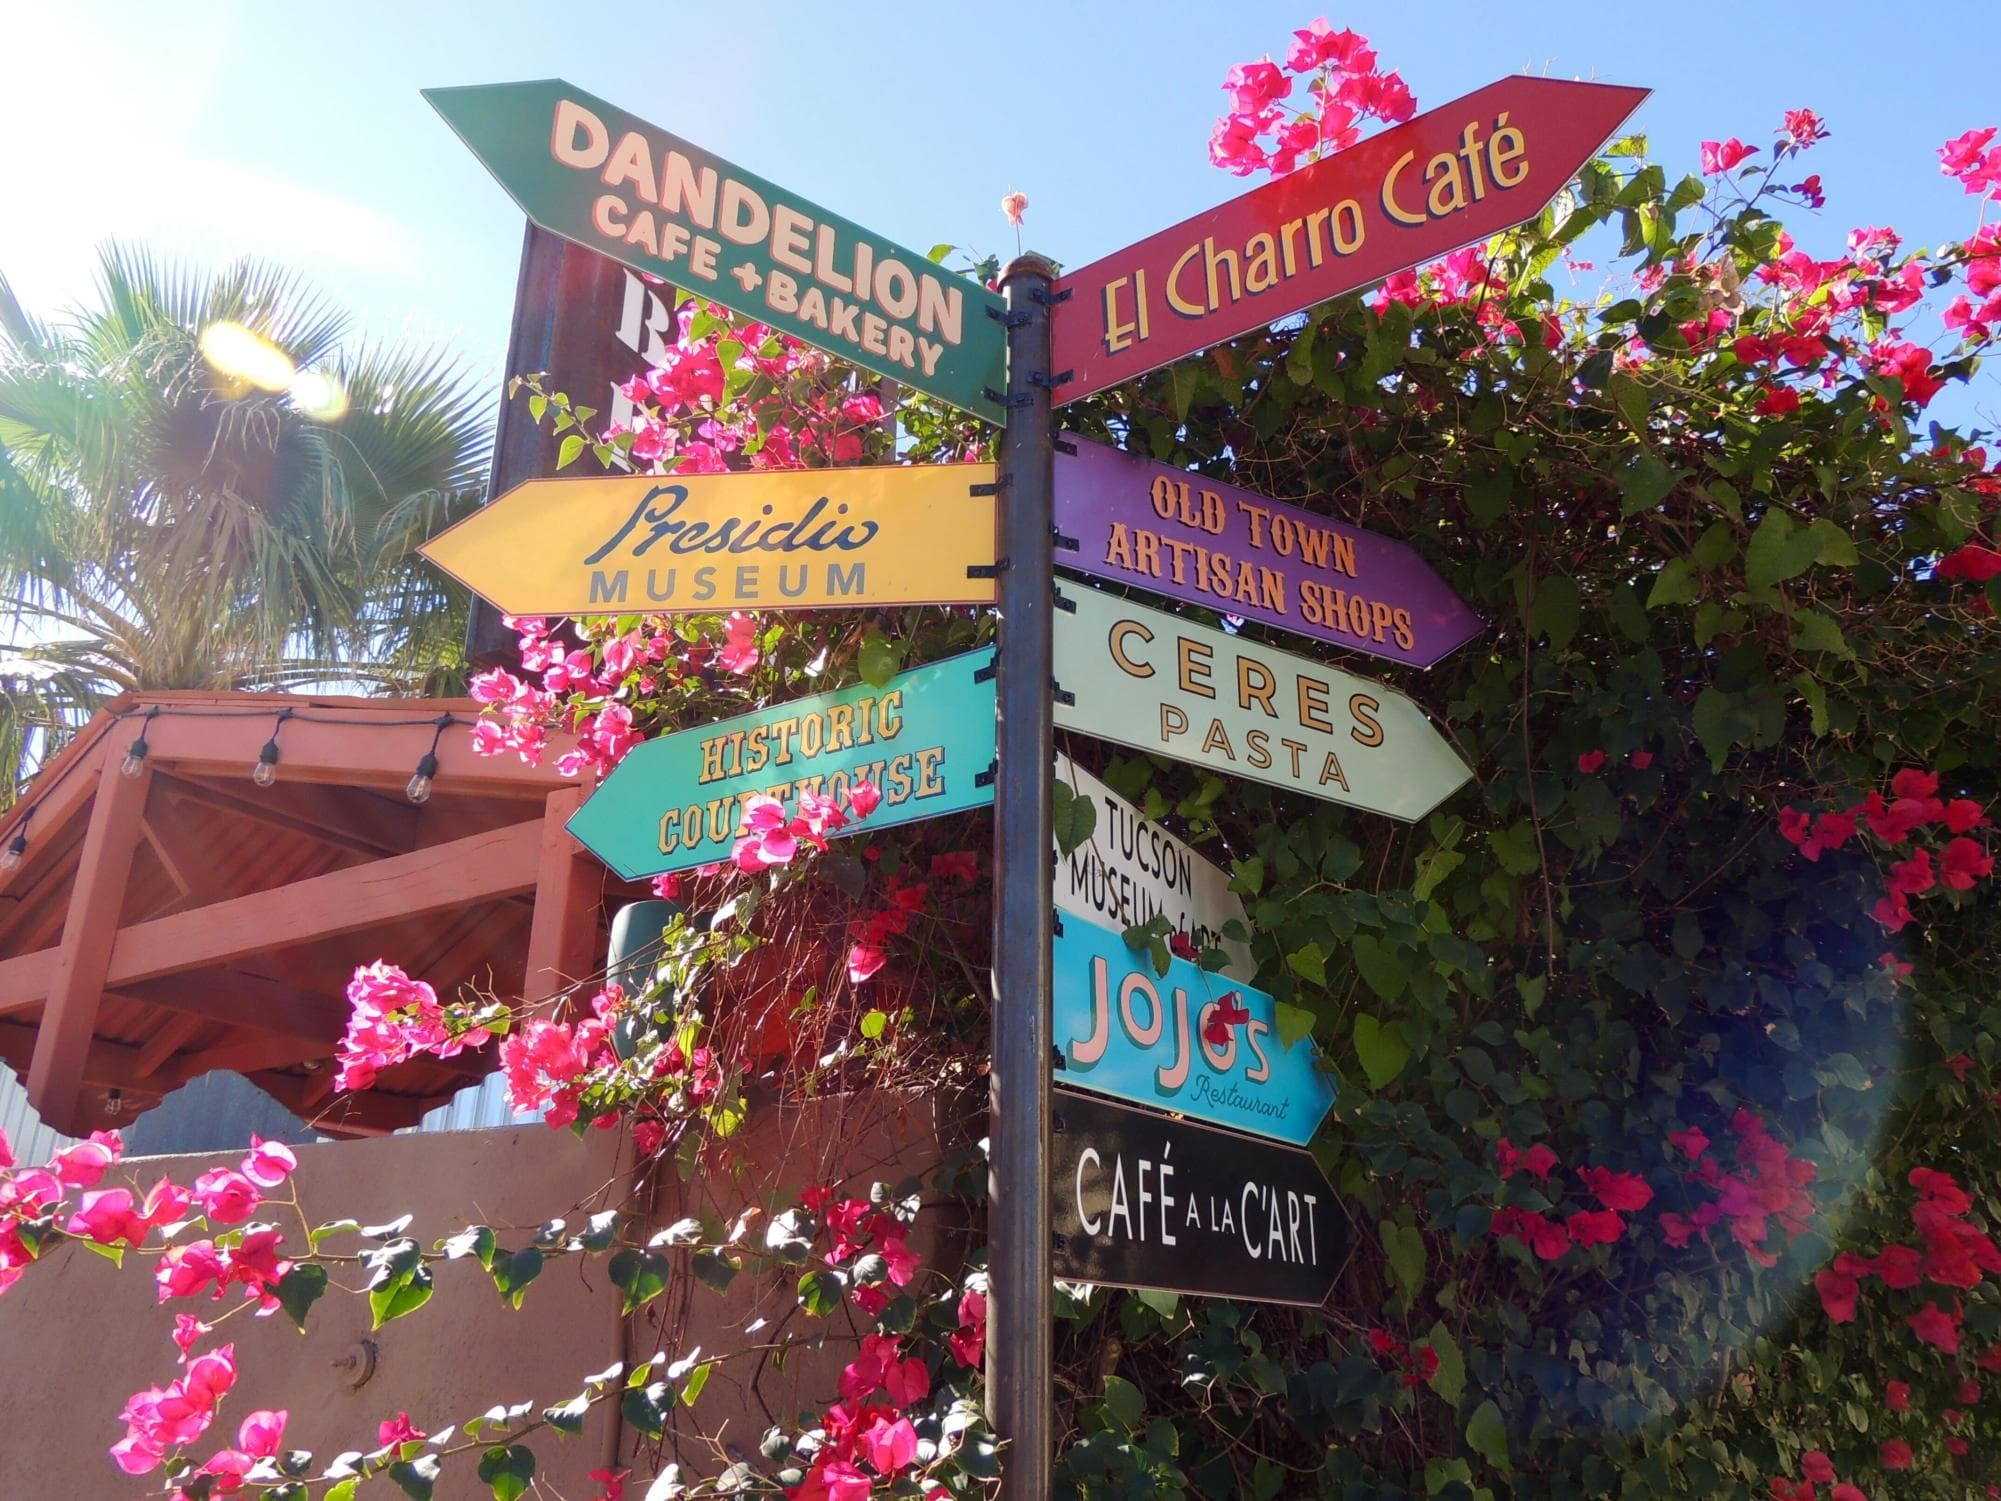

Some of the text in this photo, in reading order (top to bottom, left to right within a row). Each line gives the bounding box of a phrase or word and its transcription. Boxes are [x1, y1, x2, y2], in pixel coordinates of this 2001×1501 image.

[551, 99, 964, 346] DANDELION
[592, 195, 722, 282] CAFE
[1104, 111, 1530, 355] El Charro Café
[584, 484, 880, 565] Presidio
[1150, 475, 1358, 578] OLD TOWN
[589, 562, 866, 604] MUSEUM
[1104, 522, 1416, 652] ARTISAN SHOPS
[1108, 618, 1385, 748] CERES
[698, 690, 904, 786] HISTORIC
[1160, 702, 1351, 793] PASTA
[1104, 797, 1192, 900] TUCSON
[1190, 1073, 1291, 1121] Restaurant
[1076, 1140, 1177, 1247] CAFÉ
[1211, 1195, 1235, 1234] LA
[1241, 1181, 1317, 1266] C'ART
